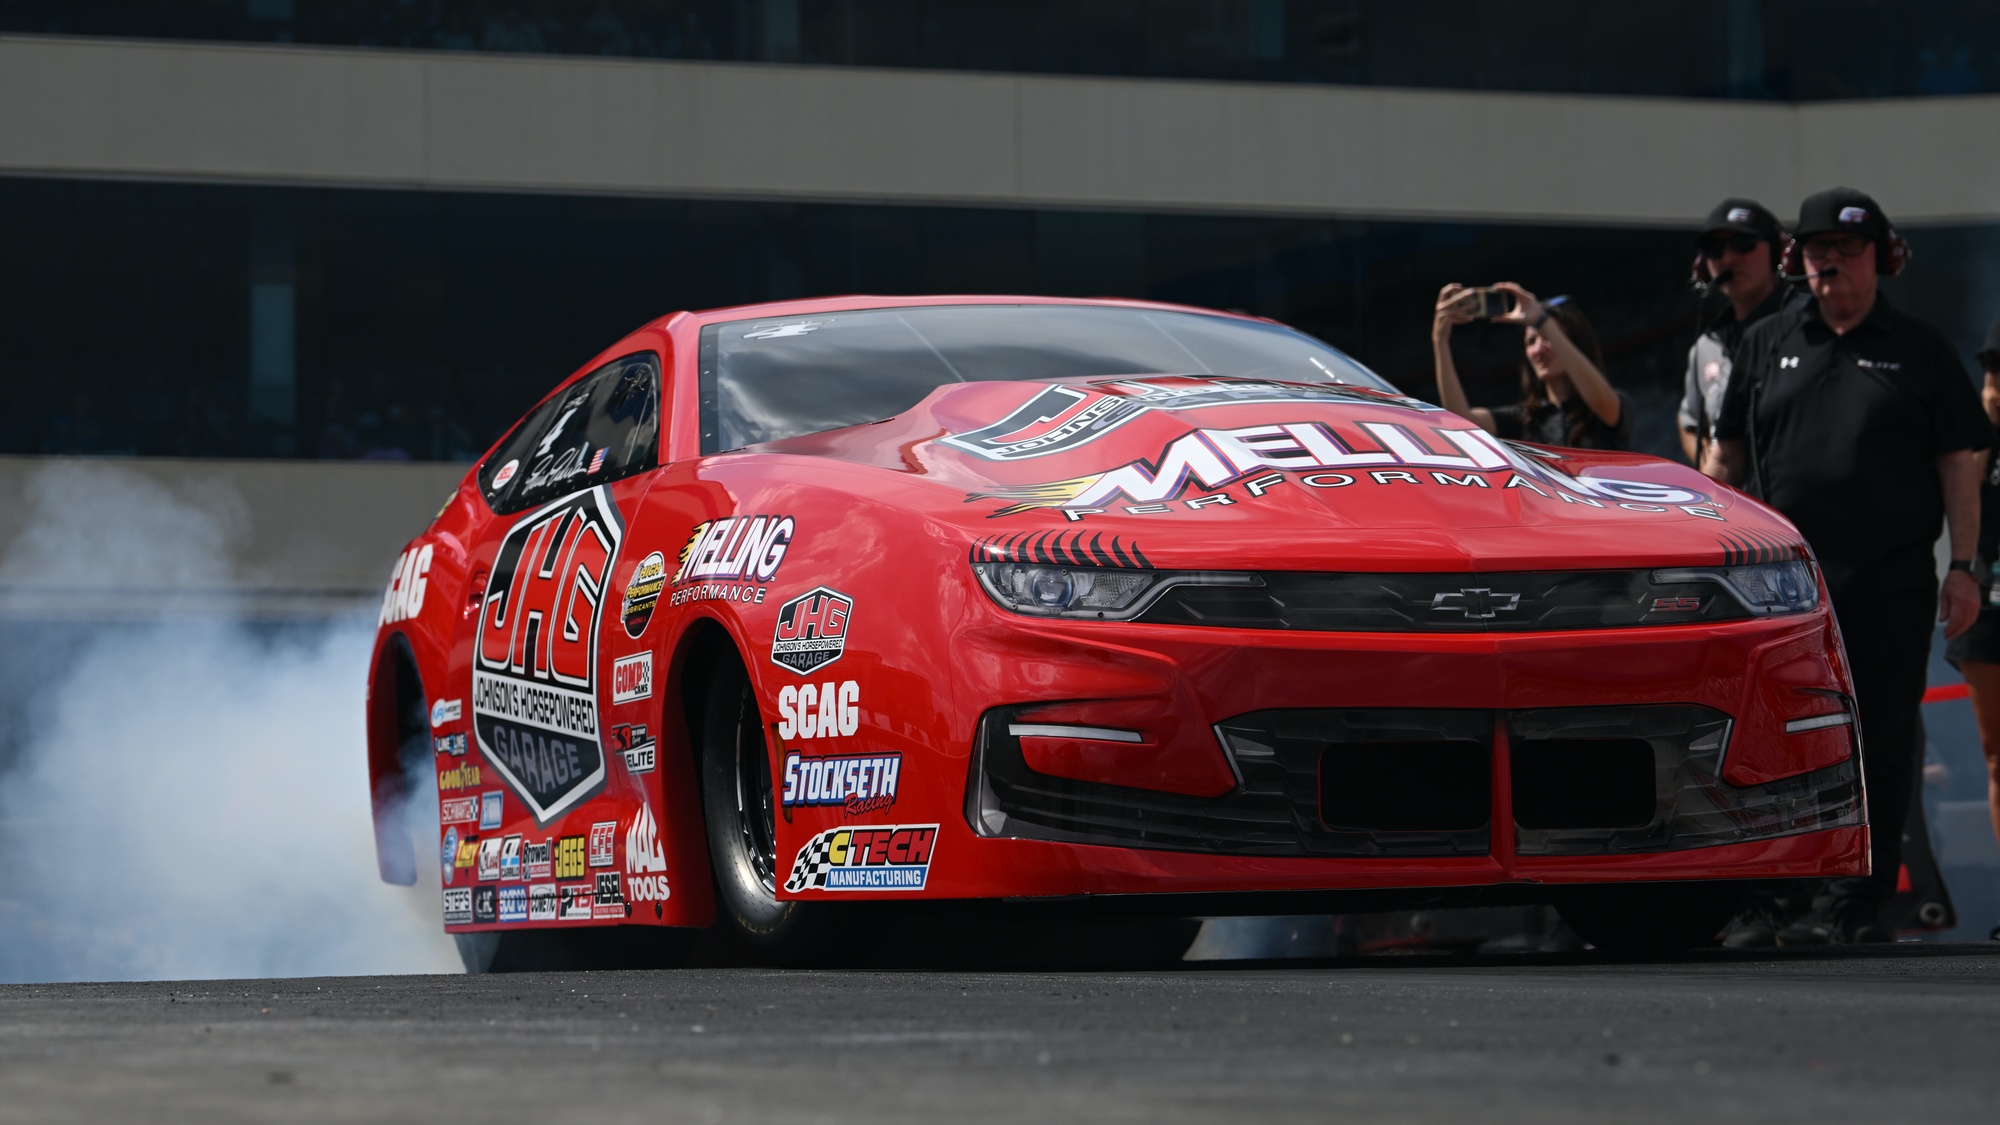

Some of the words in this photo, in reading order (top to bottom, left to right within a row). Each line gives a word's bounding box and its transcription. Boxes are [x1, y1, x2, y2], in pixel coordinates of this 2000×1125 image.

[1062, 470, 1728, 522] PERFORMANCE
[674, 515, 795, 583] MELLING
[638, 563, 662, 580] HIGH
[480, 505, 614, 688] JHG
[626, 579, 664, 599] PERFORMANCE
[669, 583, 767, 608] PERFORMANCE
[1651, 596, 1700, 612] SS
[778, 594, 849, 641] JHG
[774, 641, 801, 652] JOHNSON'S
[801, 639, 843, 650] HORSEPOWERED
[782, 651, 830, 668] GARAGE
[615, 661, 642, 694] COMP
[634, 683, 648, 695] CAMS
[475, 677, 519, 717] JOHNSON'S
[520, 686, 595, 735] HORSEPOWERED
[778, 680, 860, 741] SCAG
[493, 725, 582, 794] GARAGE
[626, 751, 654, 768] ELITE
[440, 762, 481, 793] GOODYEAR
[783, 753, 901, 804] STOCKSETH
[844, 792, 894, 818] Racing
[626, 802, 667, 874] MAC
[555, 836, 585, 878] JEGS
[628, 876, 670, 901] TOOLS
[830, 870, 921, 885] MANUFACTURING
